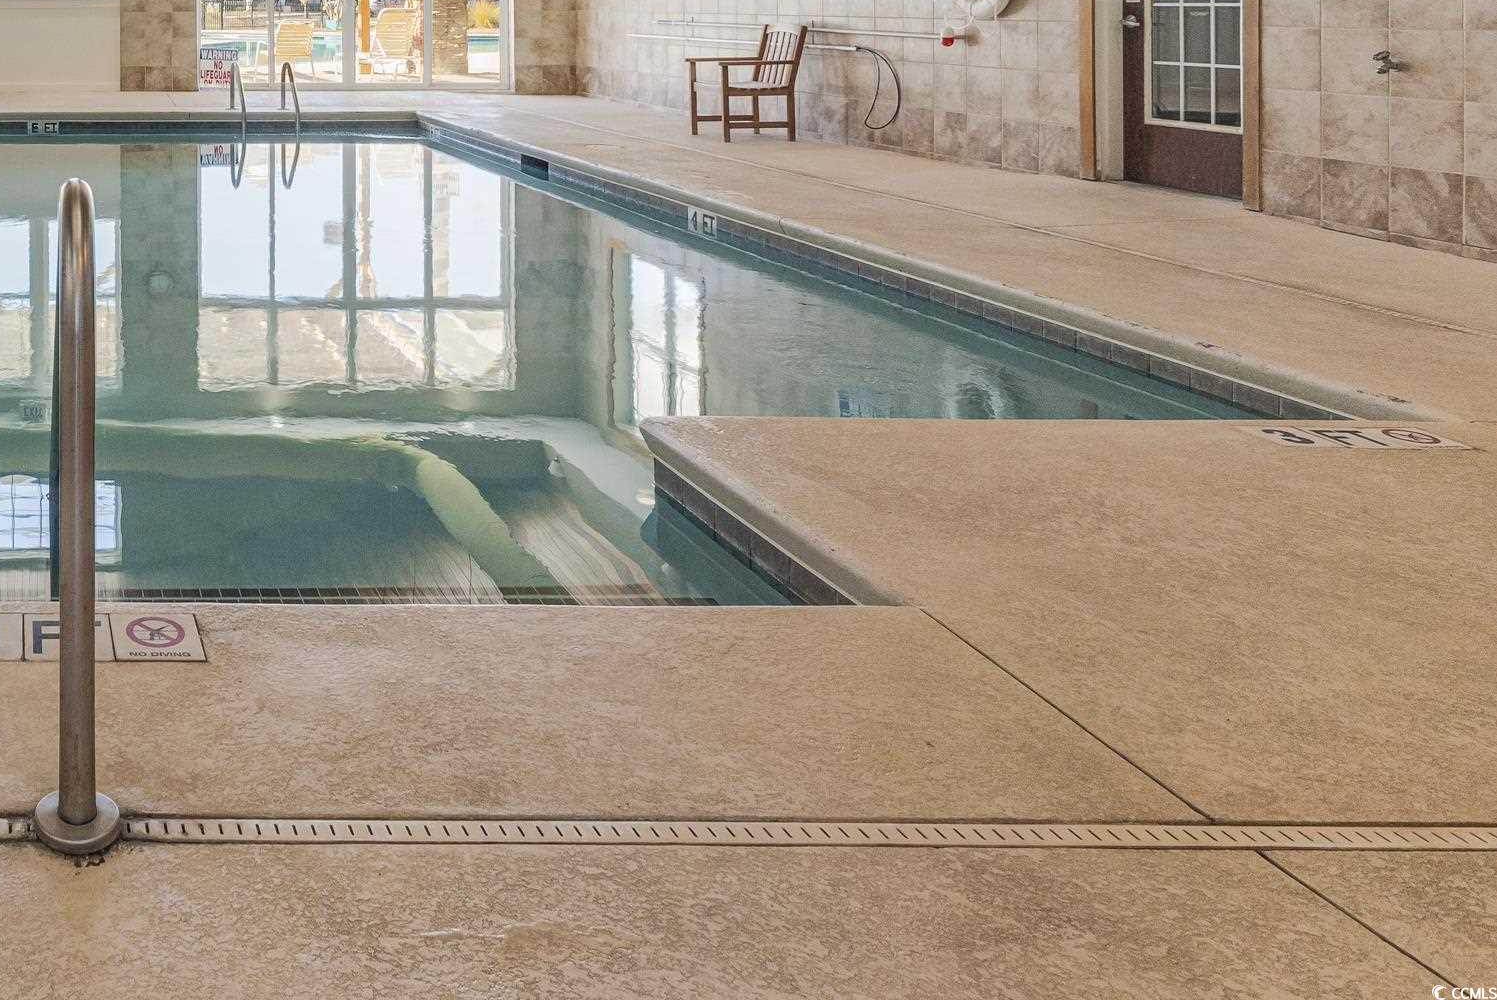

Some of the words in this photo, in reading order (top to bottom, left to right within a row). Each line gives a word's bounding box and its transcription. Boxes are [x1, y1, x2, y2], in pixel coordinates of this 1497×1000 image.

[201, 49, 238, 60] WARNING
[213, 60, 223, 70] NO
[1261, 428, 1316, 445] 3
[1309, 429, 1389, 447] FT
